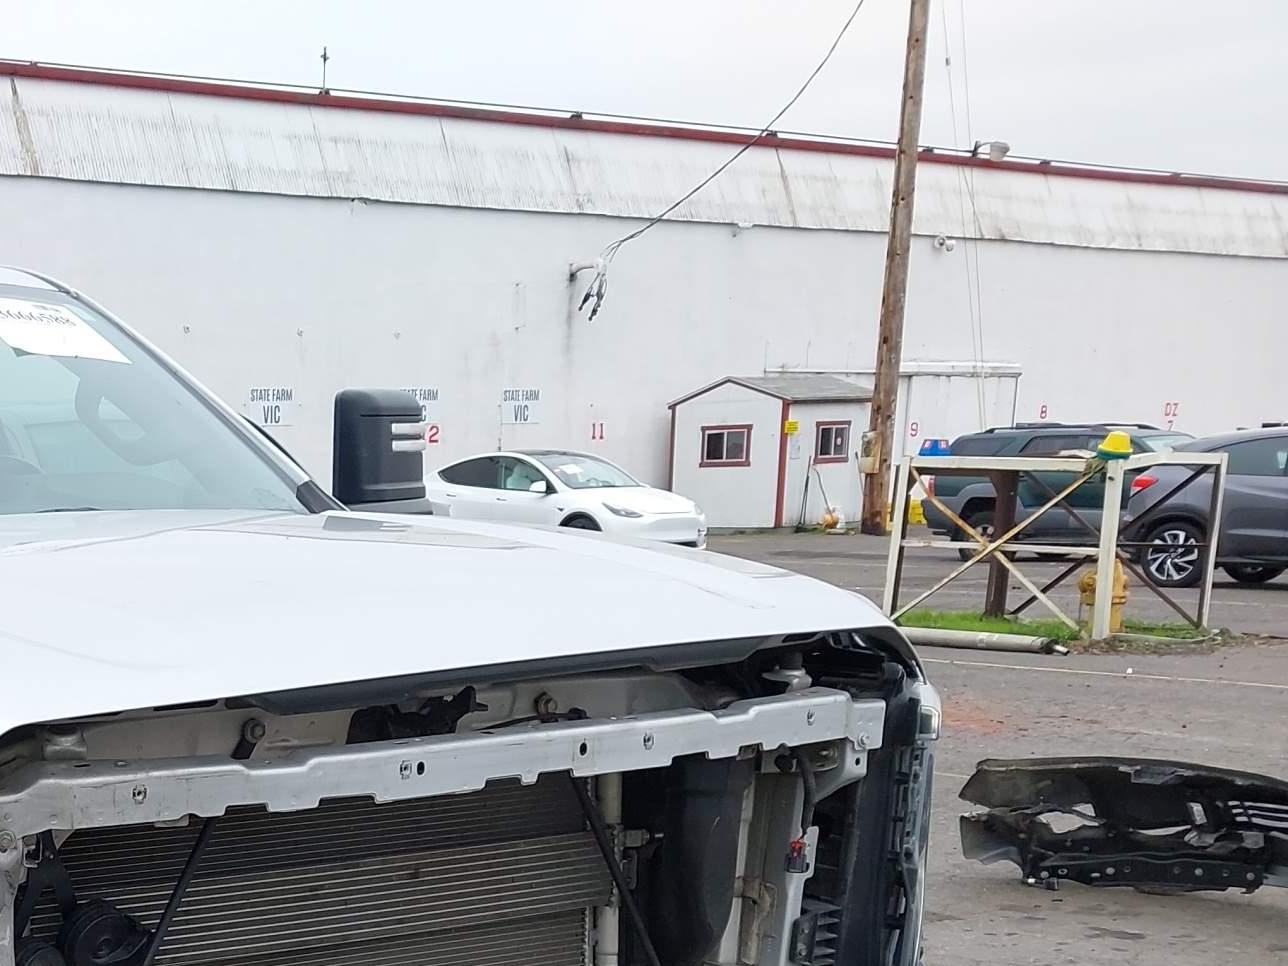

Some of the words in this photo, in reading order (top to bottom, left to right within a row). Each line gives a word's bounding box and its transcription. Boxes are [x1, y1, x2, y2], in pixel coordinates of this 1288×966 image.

[250, 389, 271, 402] STATE
[272, 388, 293, 401] FARM
[419, 388, 439, 401] FARM
[503, 390, 520, 402] STATE
[522, 389, 540, 401] FARM
[263, 405, 281, 424] VIC
[513, 404, 529, 422] VIC
[591, 423, 604, 440] 11
[910, 422, 919, 437] 9
